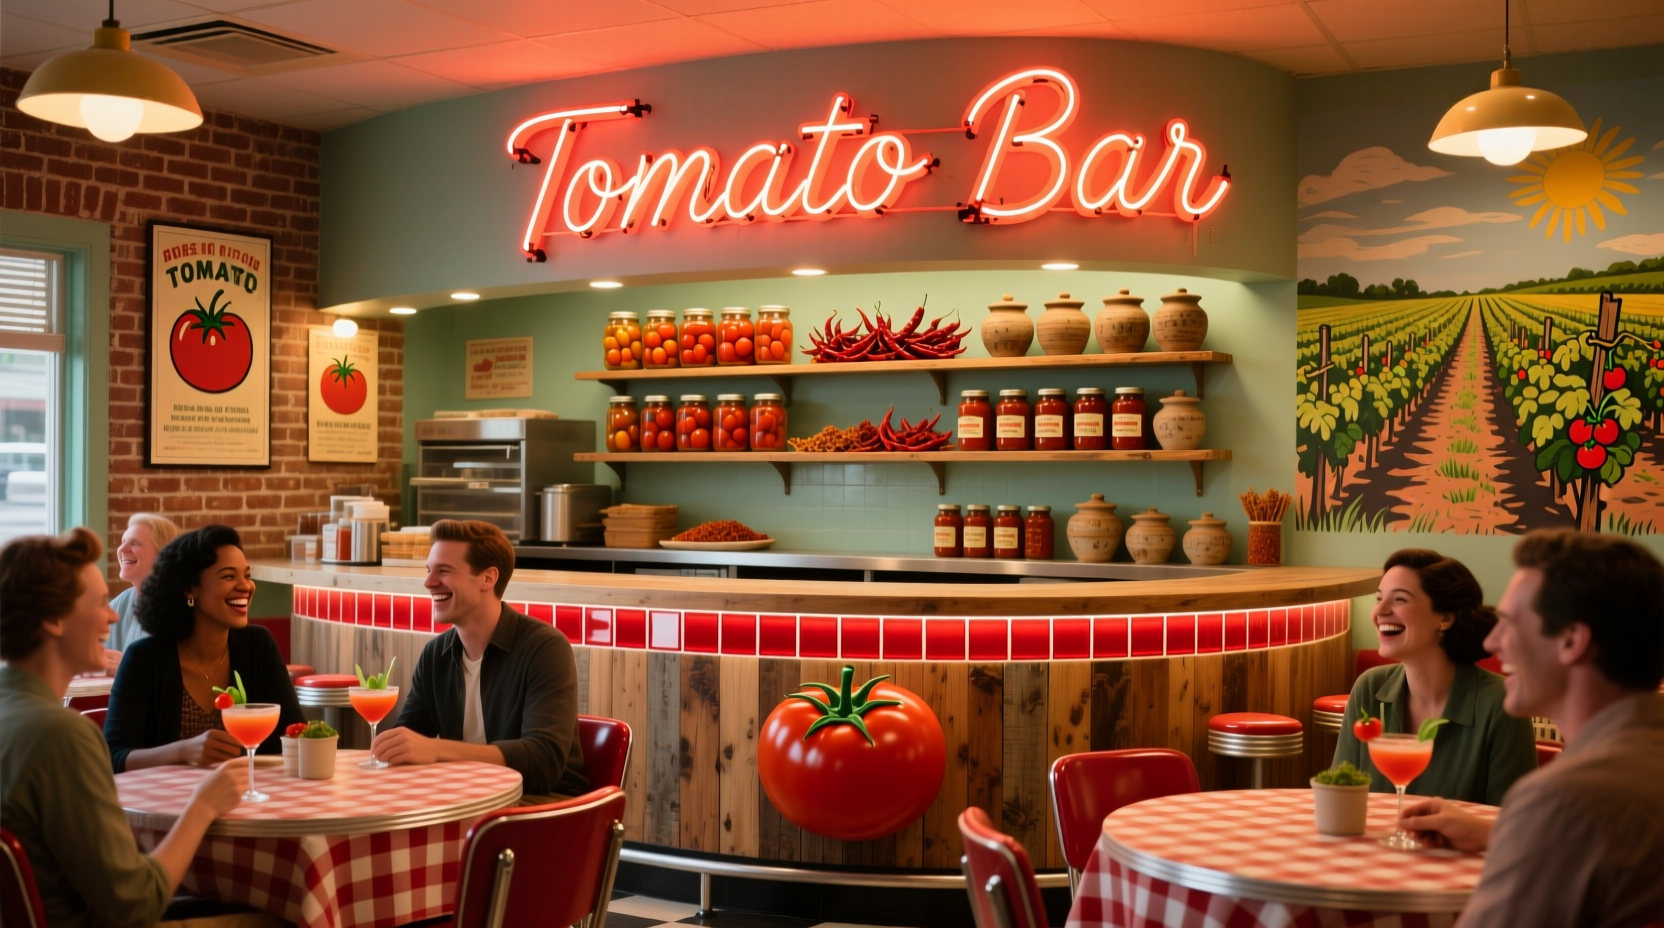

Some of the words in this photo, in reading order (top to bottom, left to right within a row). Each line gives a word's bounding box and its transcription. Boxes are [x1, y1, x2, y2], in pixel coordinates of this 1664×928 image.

[507, 93, 935, 259] Tomato
[964, 69, 1230, 225] Bar
[165, 259, 258, 294] TOMATO
